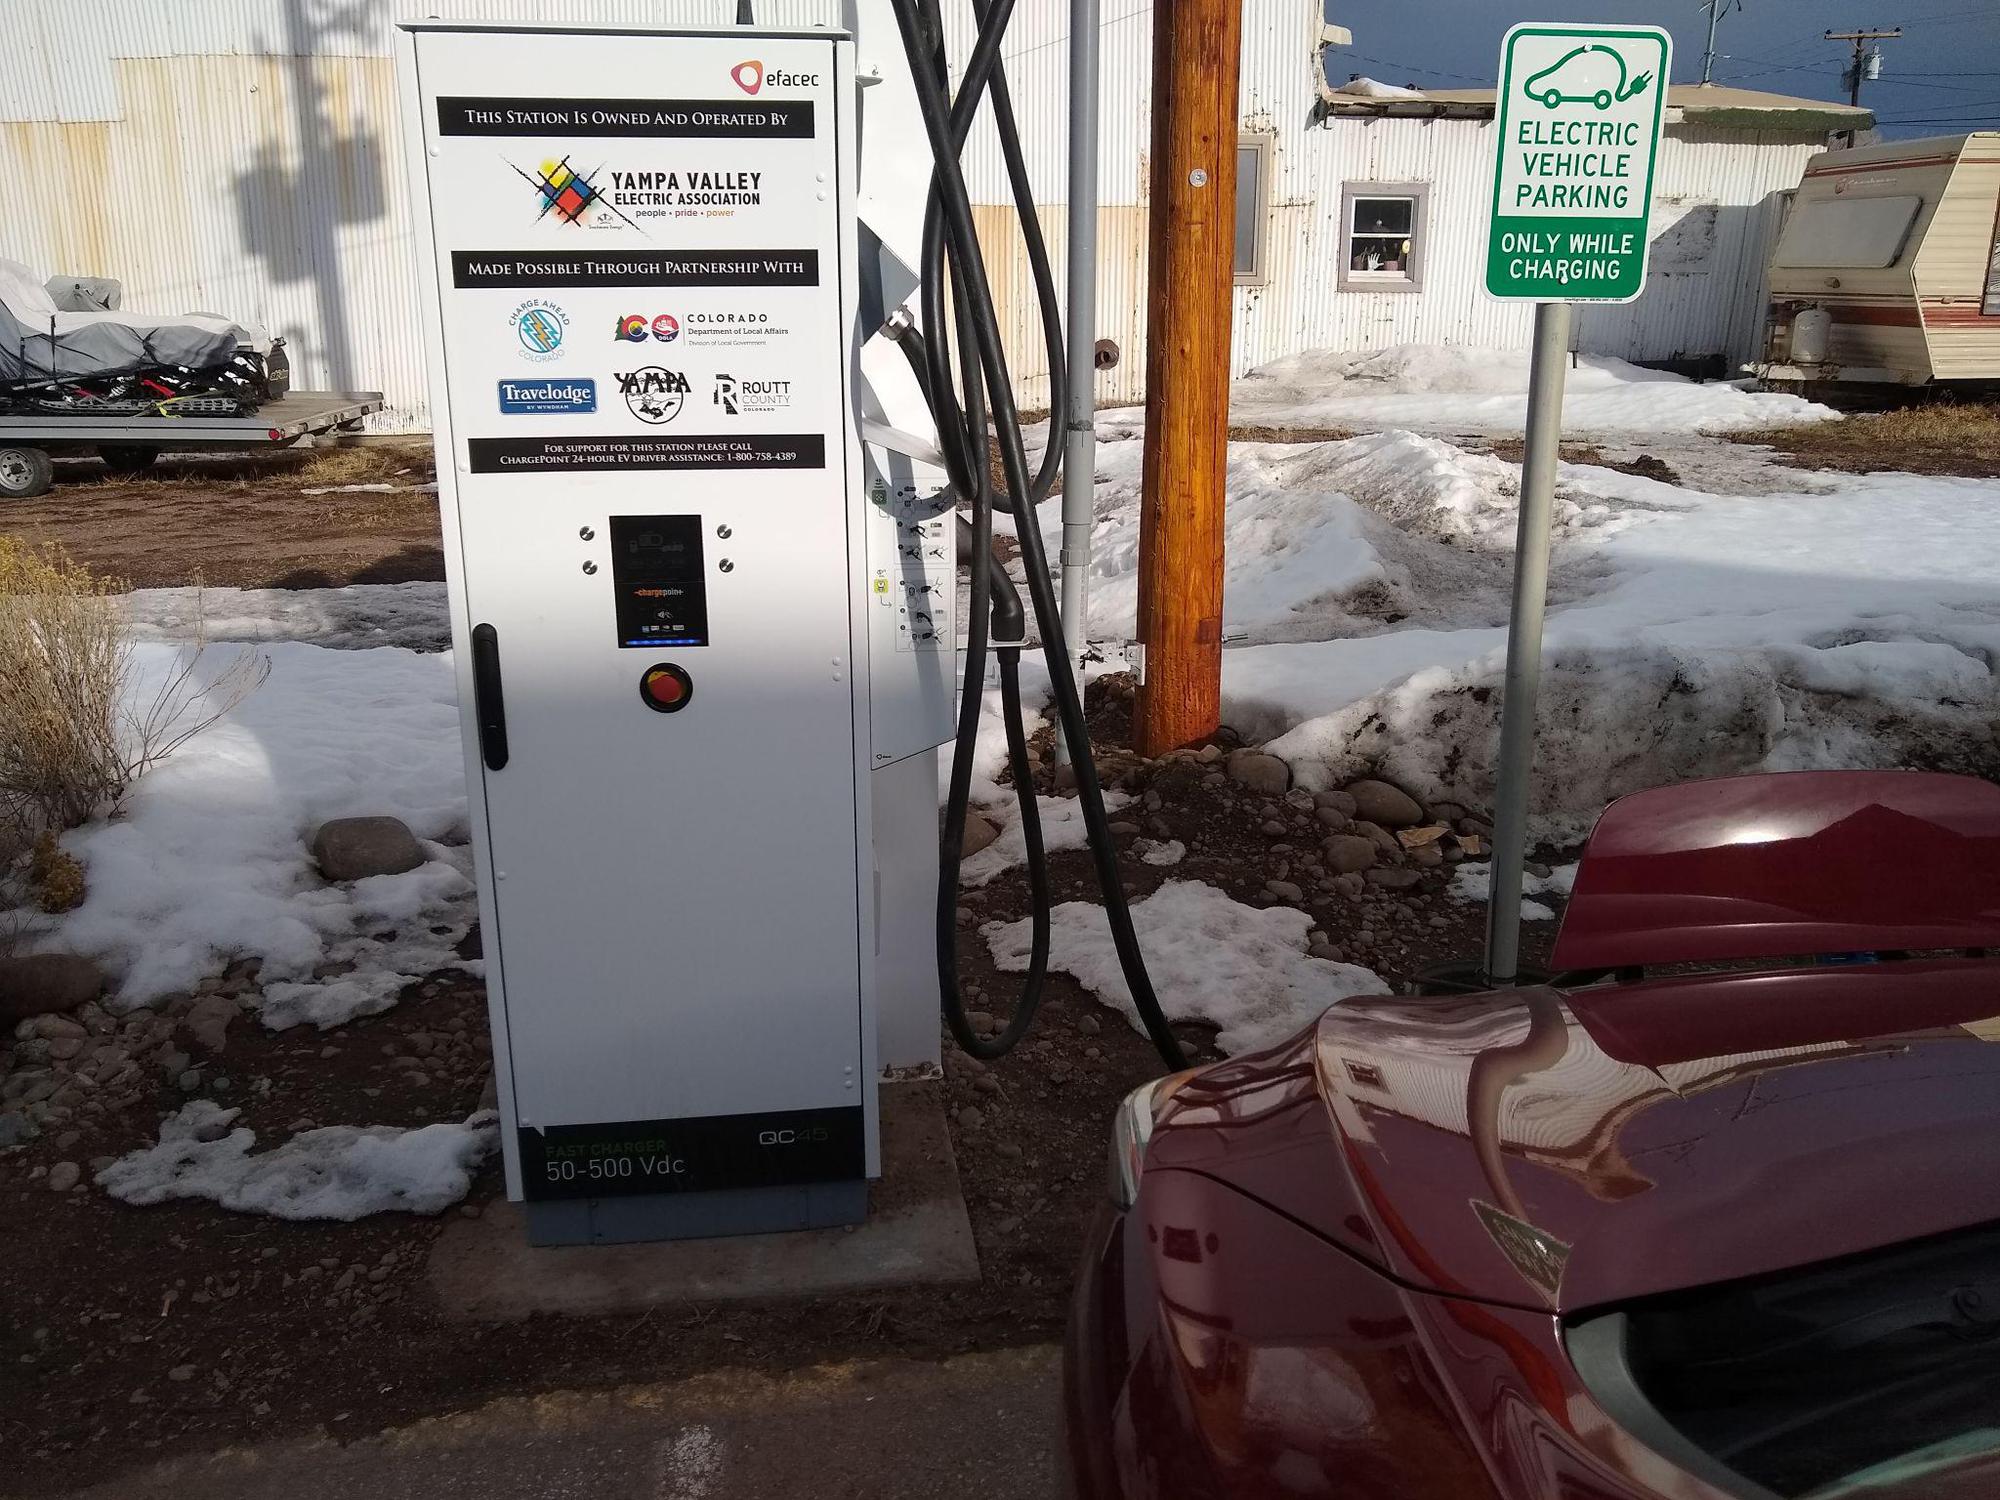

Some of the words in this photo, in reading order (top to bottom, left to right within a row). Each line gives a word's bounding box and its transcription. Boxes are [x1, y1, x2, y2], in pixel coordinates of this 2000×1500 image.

[766, 70, 819, 87] efacec
[464, 109, 502, 124] THIS
[506, 110, 569, 125] STATION
[574, 111, 588, 125] IS
[592, 111, 650, 125] OWNED
[653, 111, 688, 125] AND
[691, 111, 766, 126] OPERATED
[770, 112, 788, 126] BY
[1518, 120, 1640, 146] ELECTRIC
[1523, 152, 1631, 178] VEHICLE
[611, 172, 680, 190] YAMPA
[687, 172, 762, 190] VALLEY
[614, 192, 673, 206] ELECTRIC
[677, 192, 760, 206] ASSOCIATION
[1515, 183, 1629, 209] PARKING
[635, 208, 667, 219] people
[674, 208, 698, 218] pride
[706, 208, 735, 219] power
[1501, 232, 1561, 254] ONLY
[1569, 233, 1634, 255] WHILE
[468, 261, 512, 276] MADE
[515, 261, 581, 276] POSSIBLE
[584, 261, 661, 275] THROUGH
[664, 261, 761, 275] PARTNERSHIP
[763, 261, 804, 274] WITH
[1509, 258, 1621, 280] CHARGING
[509, 299, 540, 327] CHARGE
[542, 300, 570, 326] AHEAD
[687, 313, 768, 323] COLORADO
[687, 327, 733, 337] Department
[734, 327, 742, 335] of
[743, 327, 763, 335] Local
[764, 327, 789, 335] Affairs
[518, 348, 566, 364] COLORADO
[613, 372, 692, 394] YAMPA
[742, 381, 791, 395] ROUTT
[502, 383, 592, 404] Travelodge
[742, 395, 791, 405] COUNTY
[544, 444, 564, 453] FOR
[566, 443, 607, 453] SUPPORT
[610, 443, 630, 452] FOR
[631, 443, 653, 452] THIS
[655, 443, 695, 452] STATION
[697, 443, 729, 451] PLEASE
[730, 442, 753, 451] CALL
[571, 454, 616, 464] 24-HOUR
[617, 454, 631, 463] EV
[632, 453, 668, 463] DRIVER
[727, 452, 797, 462] 1-800-758-4389
[545, 1144, 587, 1159] FAST
[590, 1139, 667, 1155] CHARGER
[546, 1157, 632, 1182] 50-500
[642, 1155, 687, 1176] Vdc
